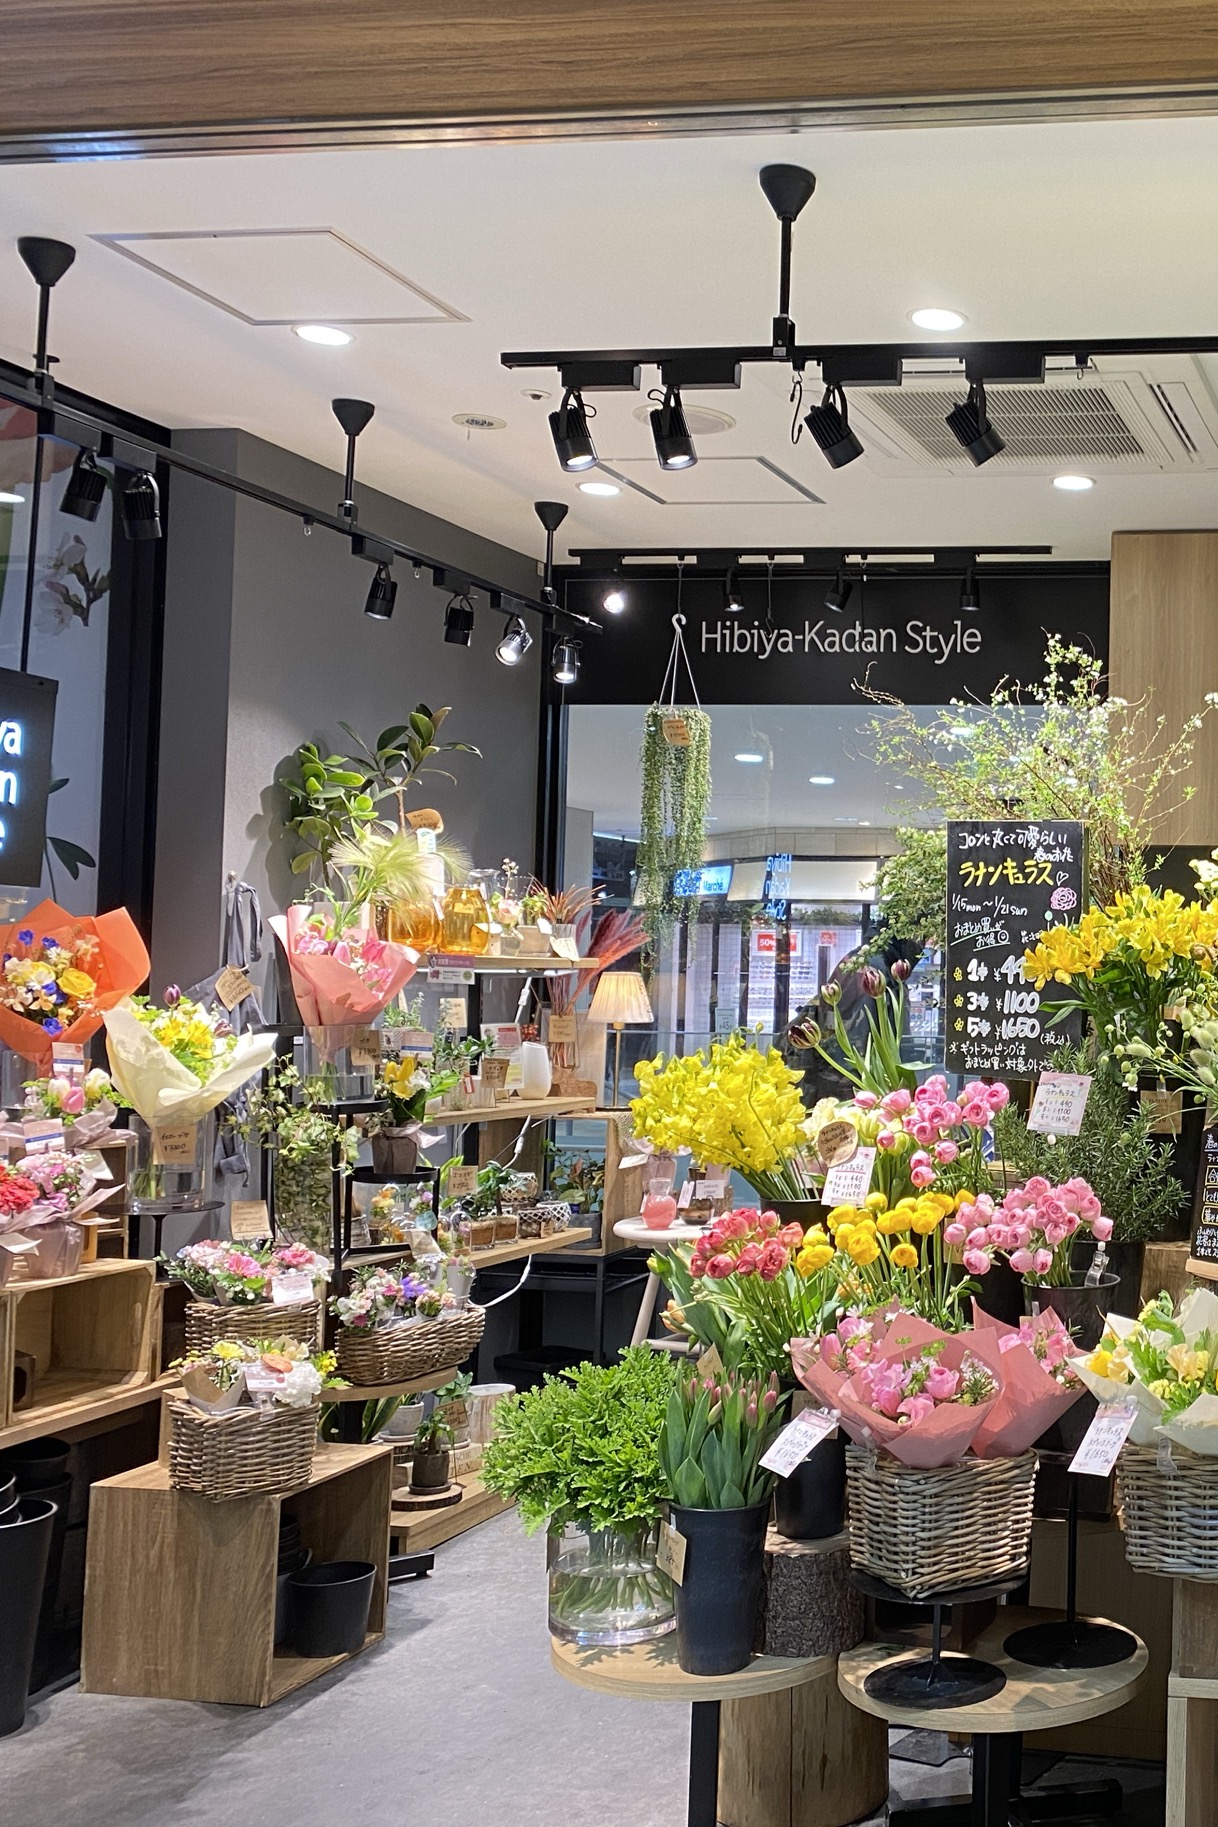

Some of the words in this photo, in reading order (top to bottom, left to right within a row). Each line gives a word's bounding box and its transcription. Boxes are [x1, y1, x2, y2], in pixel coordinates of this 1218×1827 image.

[701, 620, 897, 659] Hibiya-Kadan
[904, 620, 982, 664] Style
[959, 857, 1054, 887] ラナンキュラス
